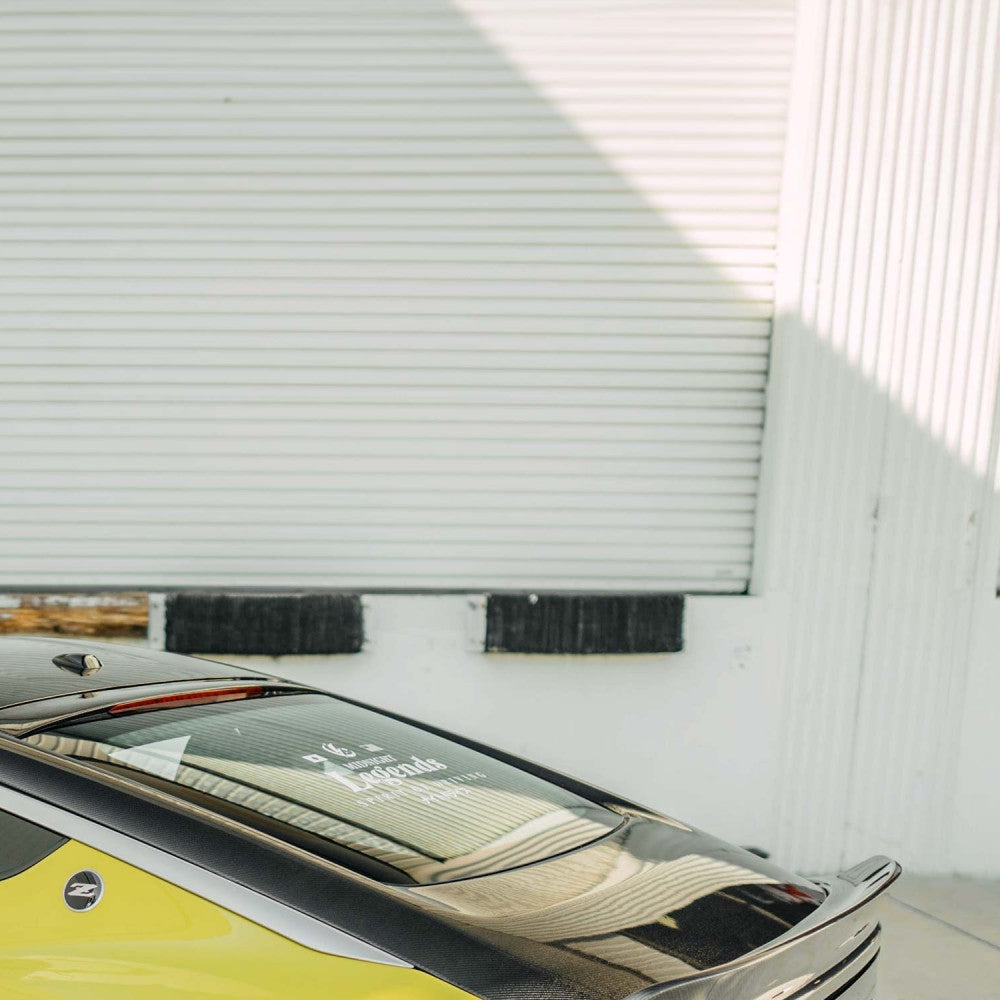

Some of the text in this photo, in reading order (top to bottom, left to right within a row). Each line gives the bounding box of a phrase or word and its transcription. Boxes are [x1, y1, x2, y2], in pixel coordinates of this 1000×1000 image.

[342, 754, 398, 770] MIDNIGHT
[324, 755, 448, 793] Legends
[432, 771, 487, 788] DRIVING
